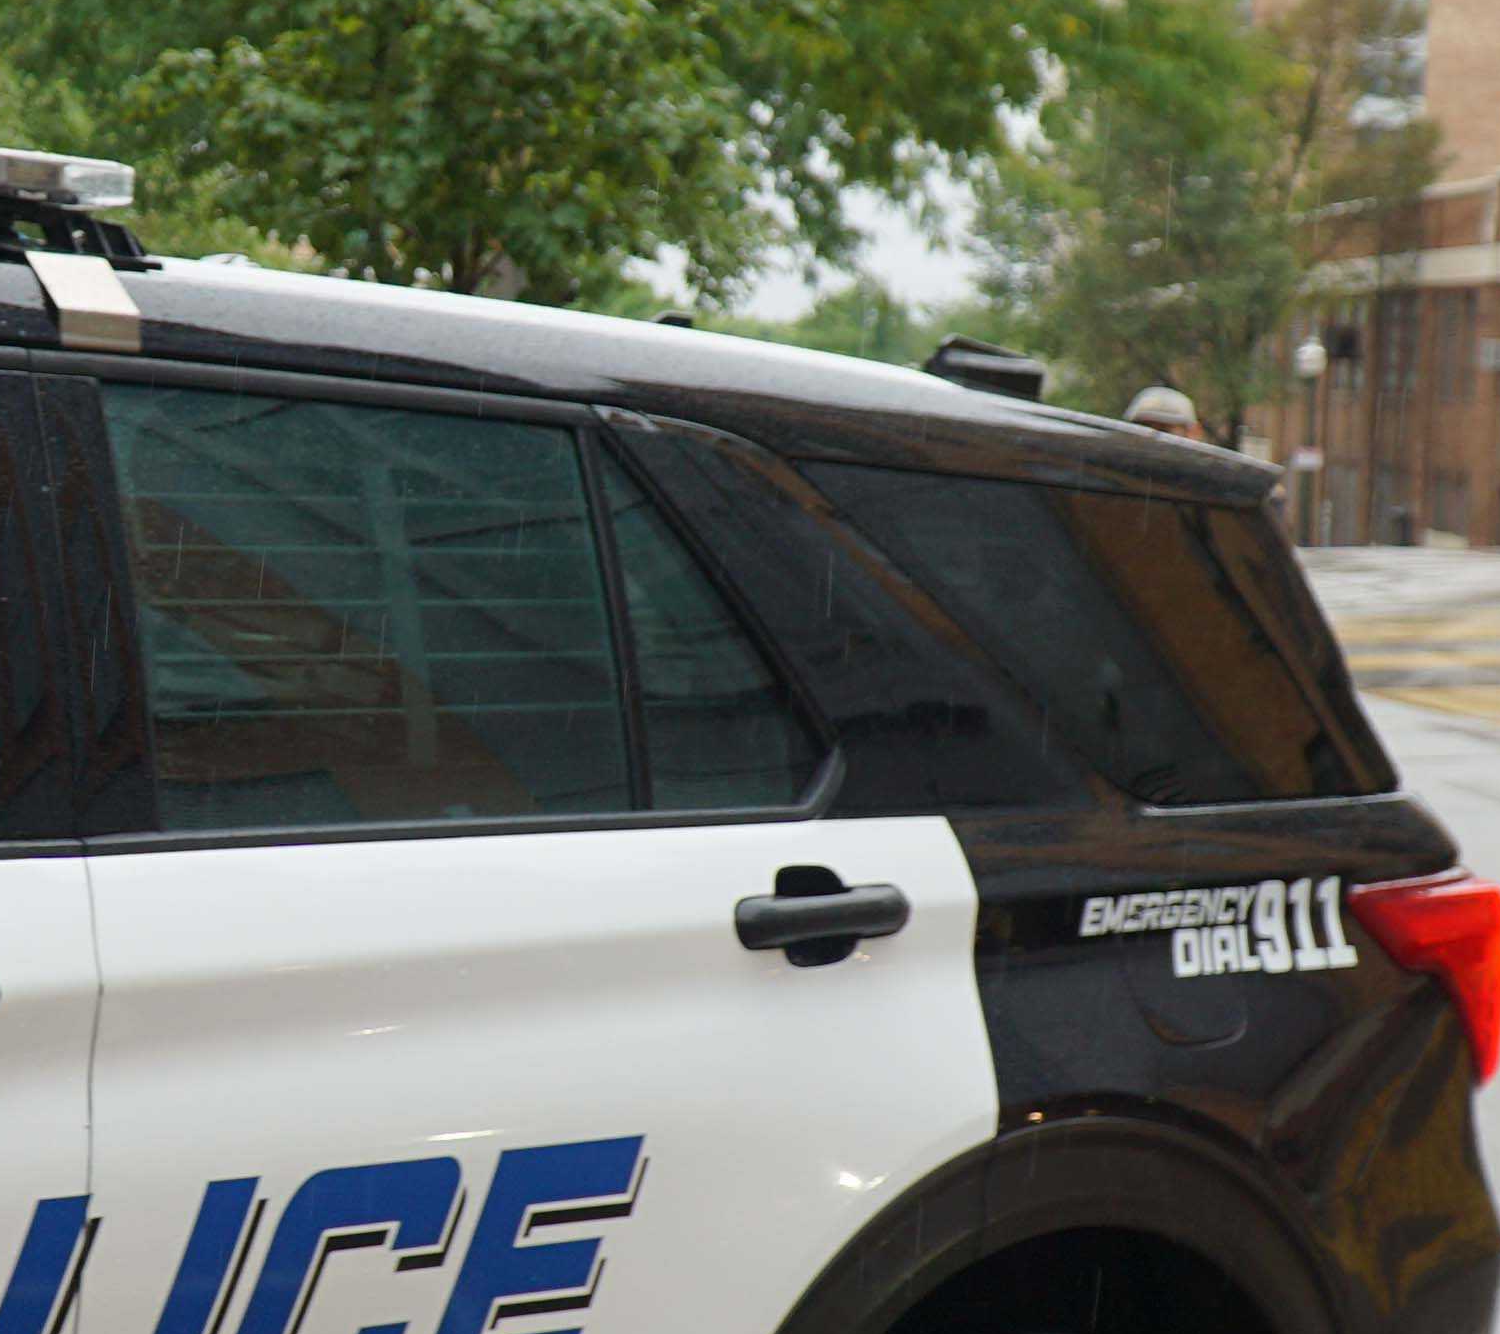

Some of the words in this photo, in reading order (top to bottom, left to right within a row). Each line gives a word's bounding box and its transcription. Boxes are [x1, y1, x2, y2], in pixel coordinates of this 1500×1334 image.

[1080, 886, 1254, 936] EMERGENCY
[1173, 925, 1261, 977] DIAL
[1254, 877, 1357, 973] 911
